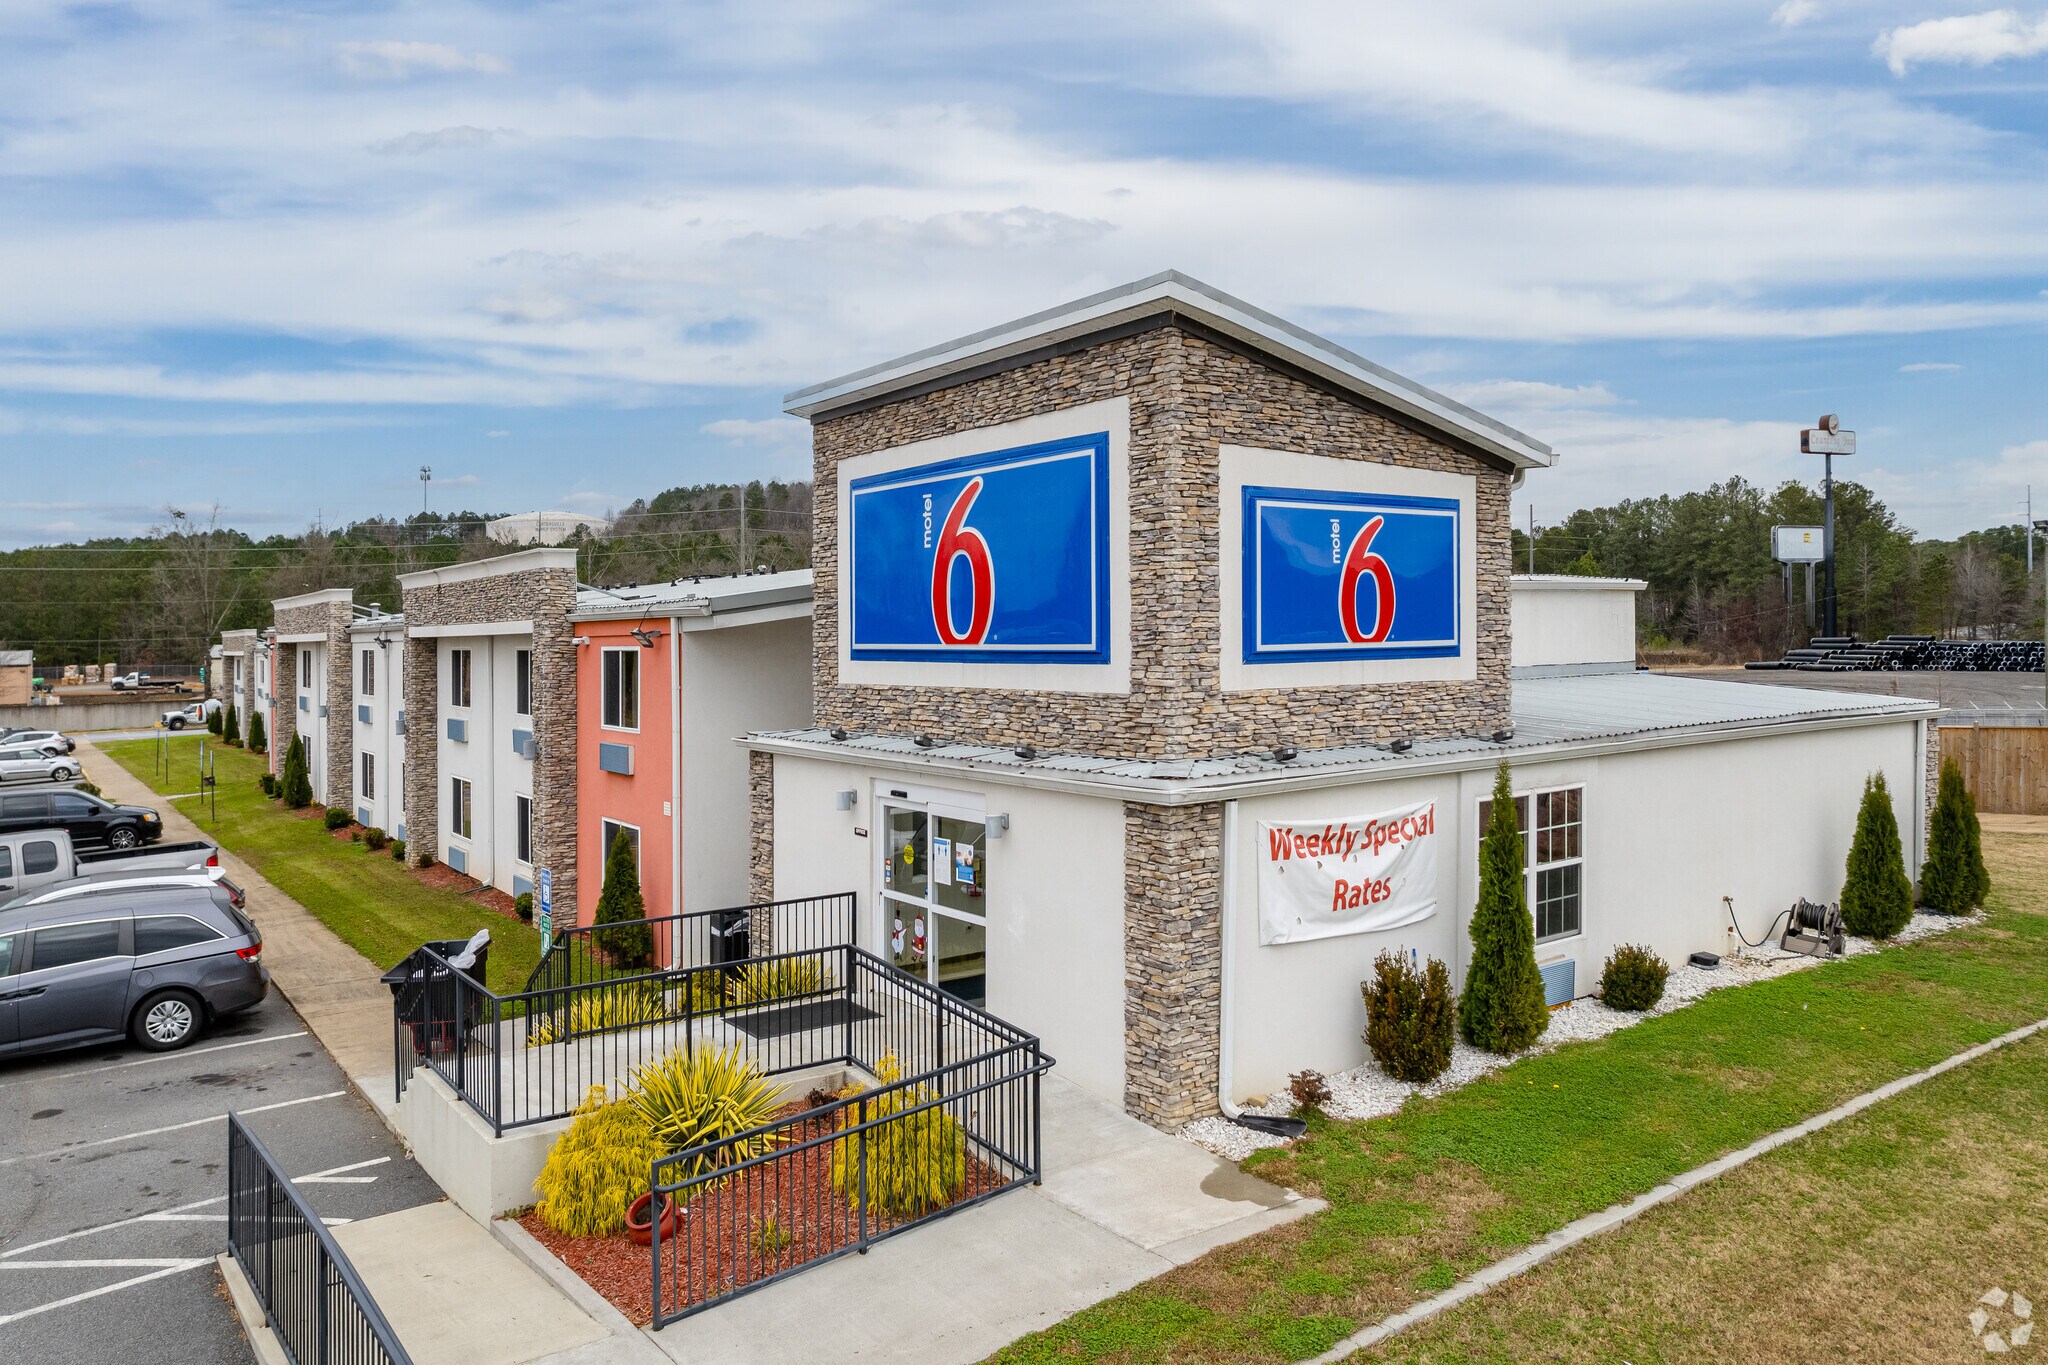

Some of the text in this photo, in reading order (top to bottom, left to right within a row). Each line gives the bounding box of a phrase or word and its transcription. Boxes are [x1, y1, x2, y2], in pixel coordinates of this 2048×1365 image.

[922, 476, 996, 645] motel 6
[1330, 515, 1396, 644] motel 6
[1269, 803, 1435, 862] Weekly Special
[1332, 876, 1392, 912] Rates
